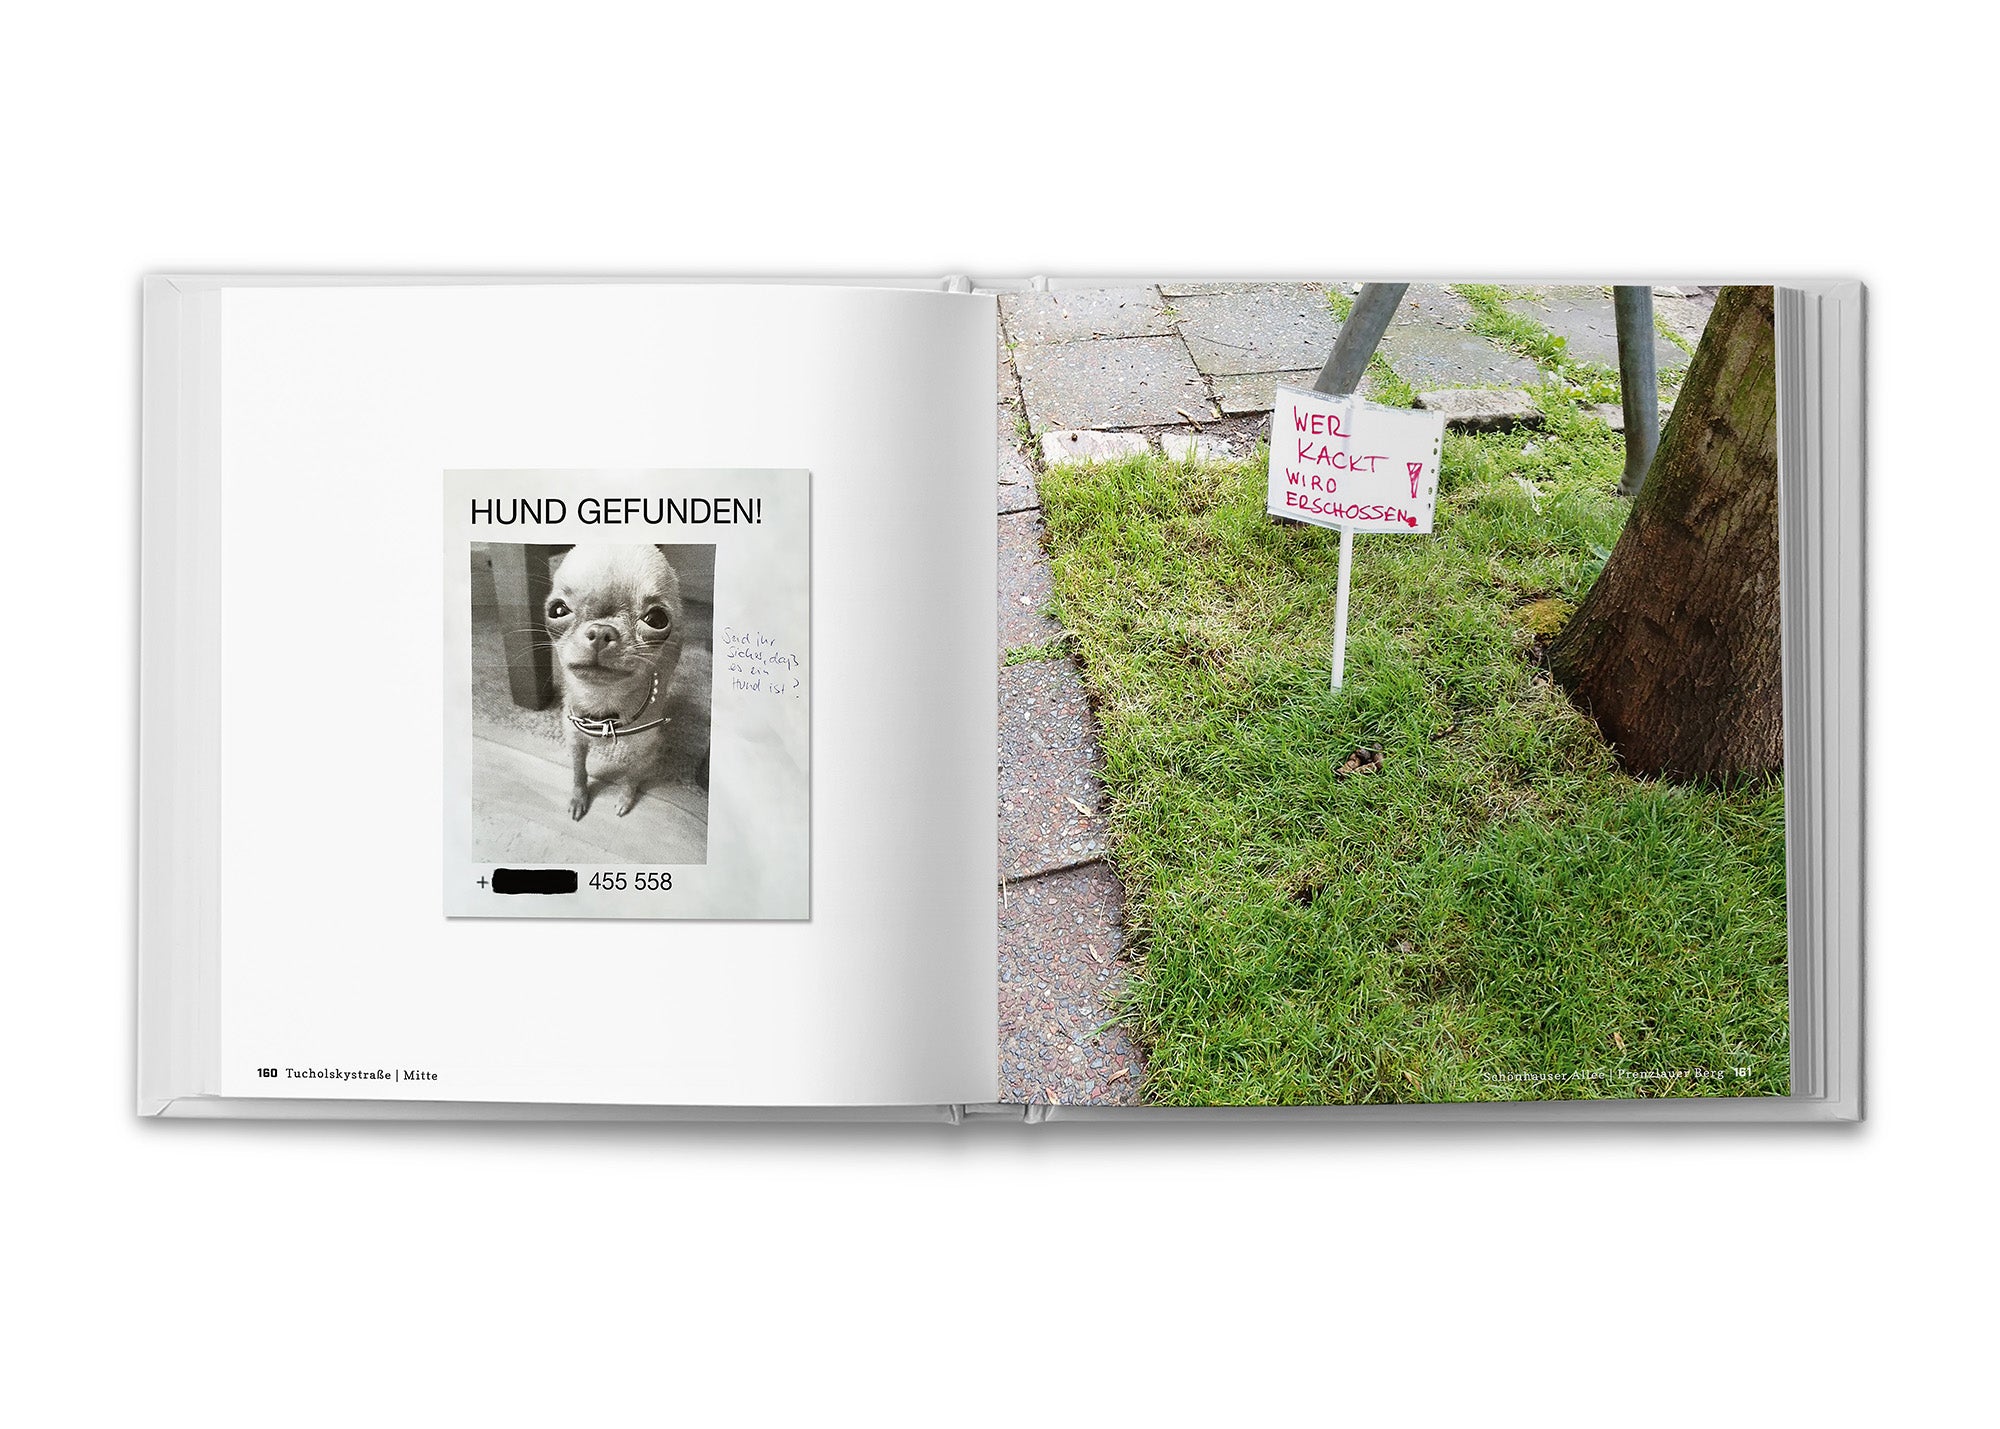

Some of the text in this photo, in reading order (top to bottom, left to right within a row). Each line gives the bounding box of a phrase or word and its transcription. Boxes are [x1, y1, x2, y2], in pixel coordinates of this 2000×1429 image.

[1293, 405, 1351, 438] WER
[1298, 438, 1390, 473] KACKT
[471, 498, 762, 525] HUND GEFUNDEN!
[756, 631, 775, 647] ihr
[732, 677, 761, 691] Hund
[588, 871, 628, 891] 455
[634, 871, 673, 892] 558
[257, 1068, 438, 1081] 160 Tucholskystraße Mitte
[1483, 1067, 1752, 1082] Schönhauser Allee Prenzlauer Berg 161
